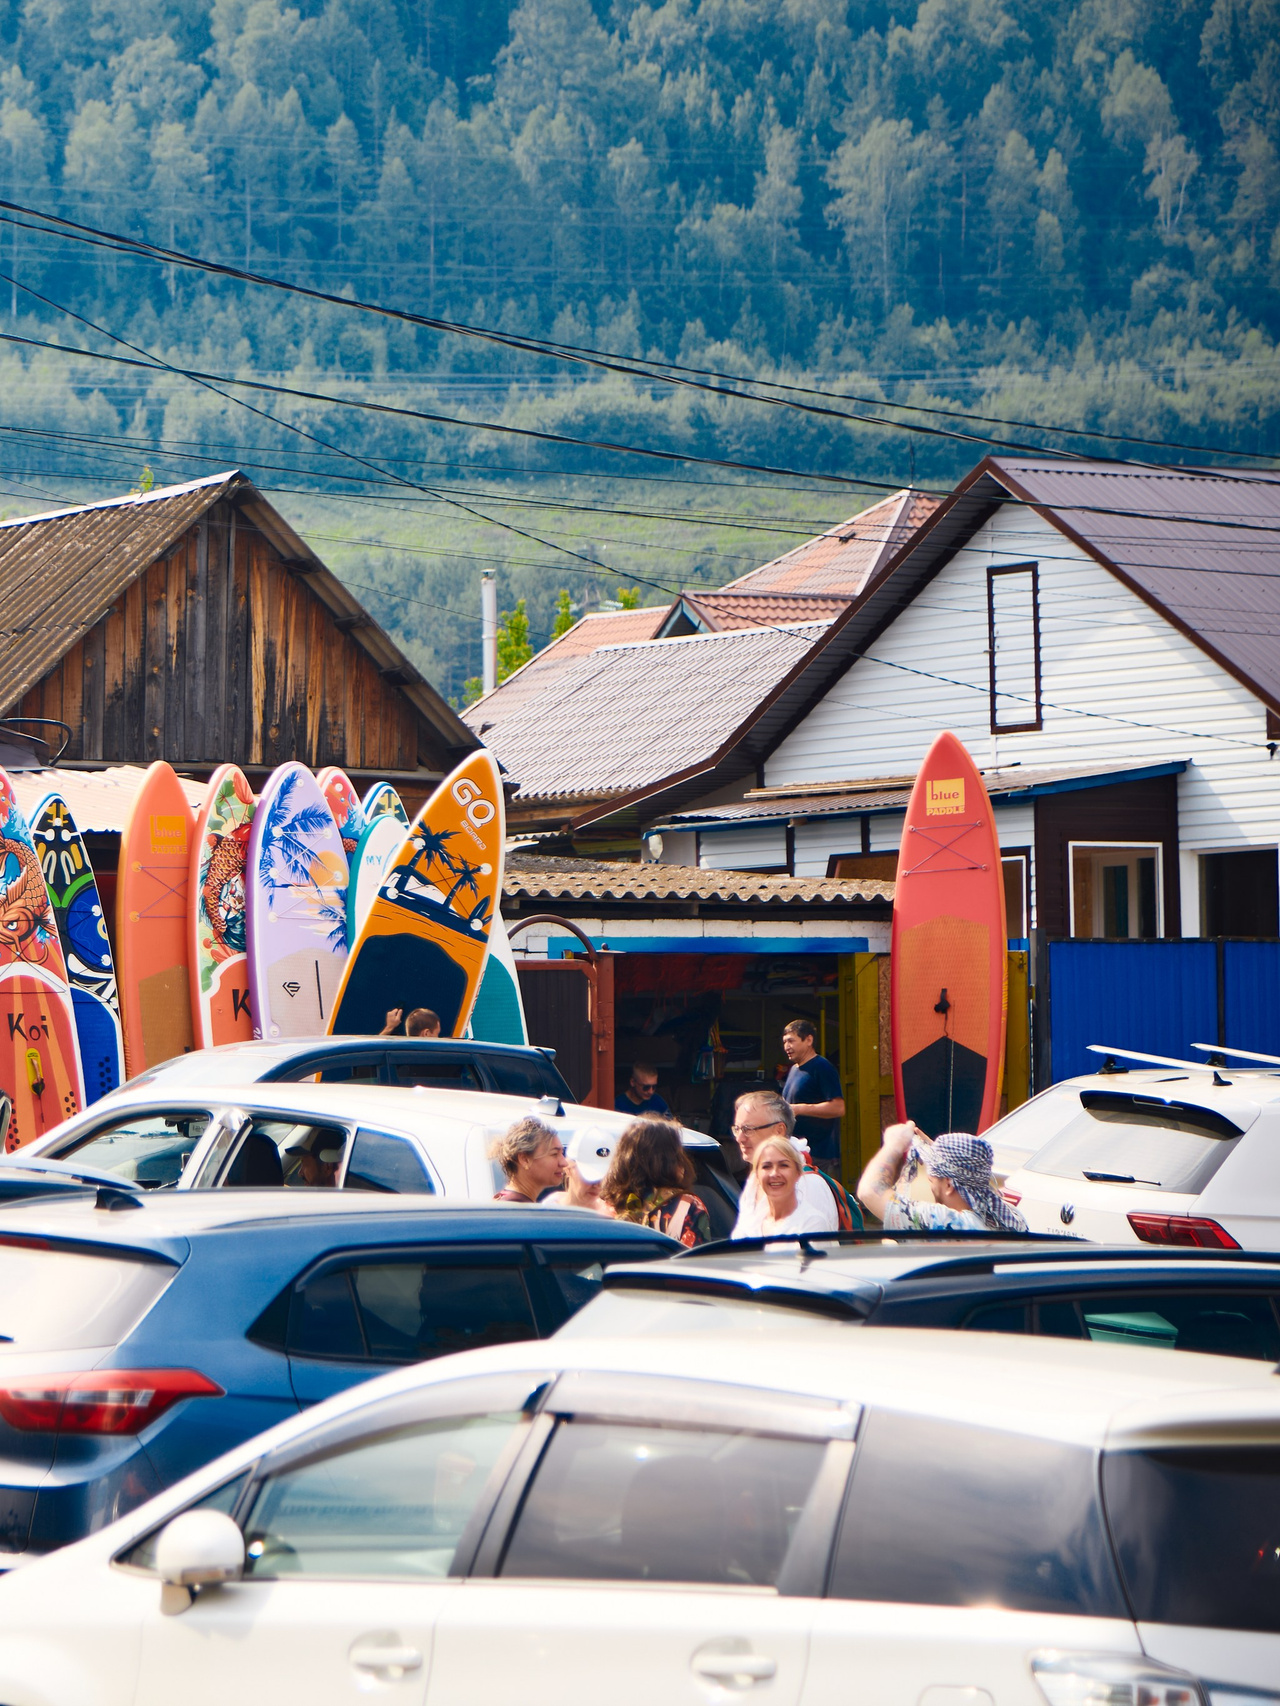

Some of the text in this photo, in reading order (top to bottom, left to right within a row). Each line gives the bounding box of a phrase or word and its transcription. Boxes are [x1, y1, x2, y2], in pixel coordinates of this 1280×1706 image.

[931, 780, 959, 800] blue
[926, 806, 965, 816] PADDLE
[154, 815, 182, 838] blue
[151, 846, 188, 855] PADDLE
[7, 1013, 49, 1042] Koi
